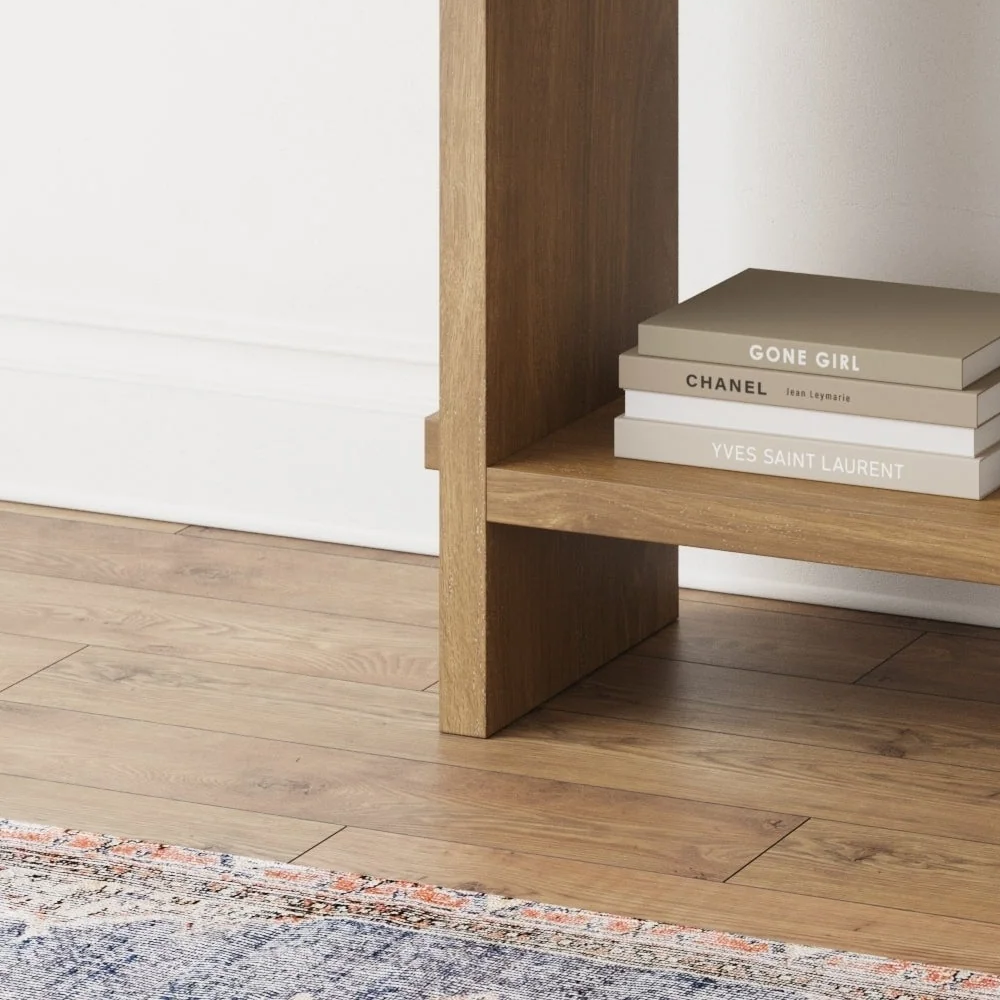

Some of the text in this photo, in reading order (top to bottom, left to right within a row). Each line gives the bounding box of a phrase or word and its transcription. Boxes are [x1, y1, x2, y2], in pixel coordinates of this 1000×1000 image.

[749, 344, 860, 372] GONE GIRL
[686, 374, 767, 396] CHANEL
[786, 387, 851, 403] Jean Leymarie
[711, 442, 905, 480] YVES SAINT LAURENT
